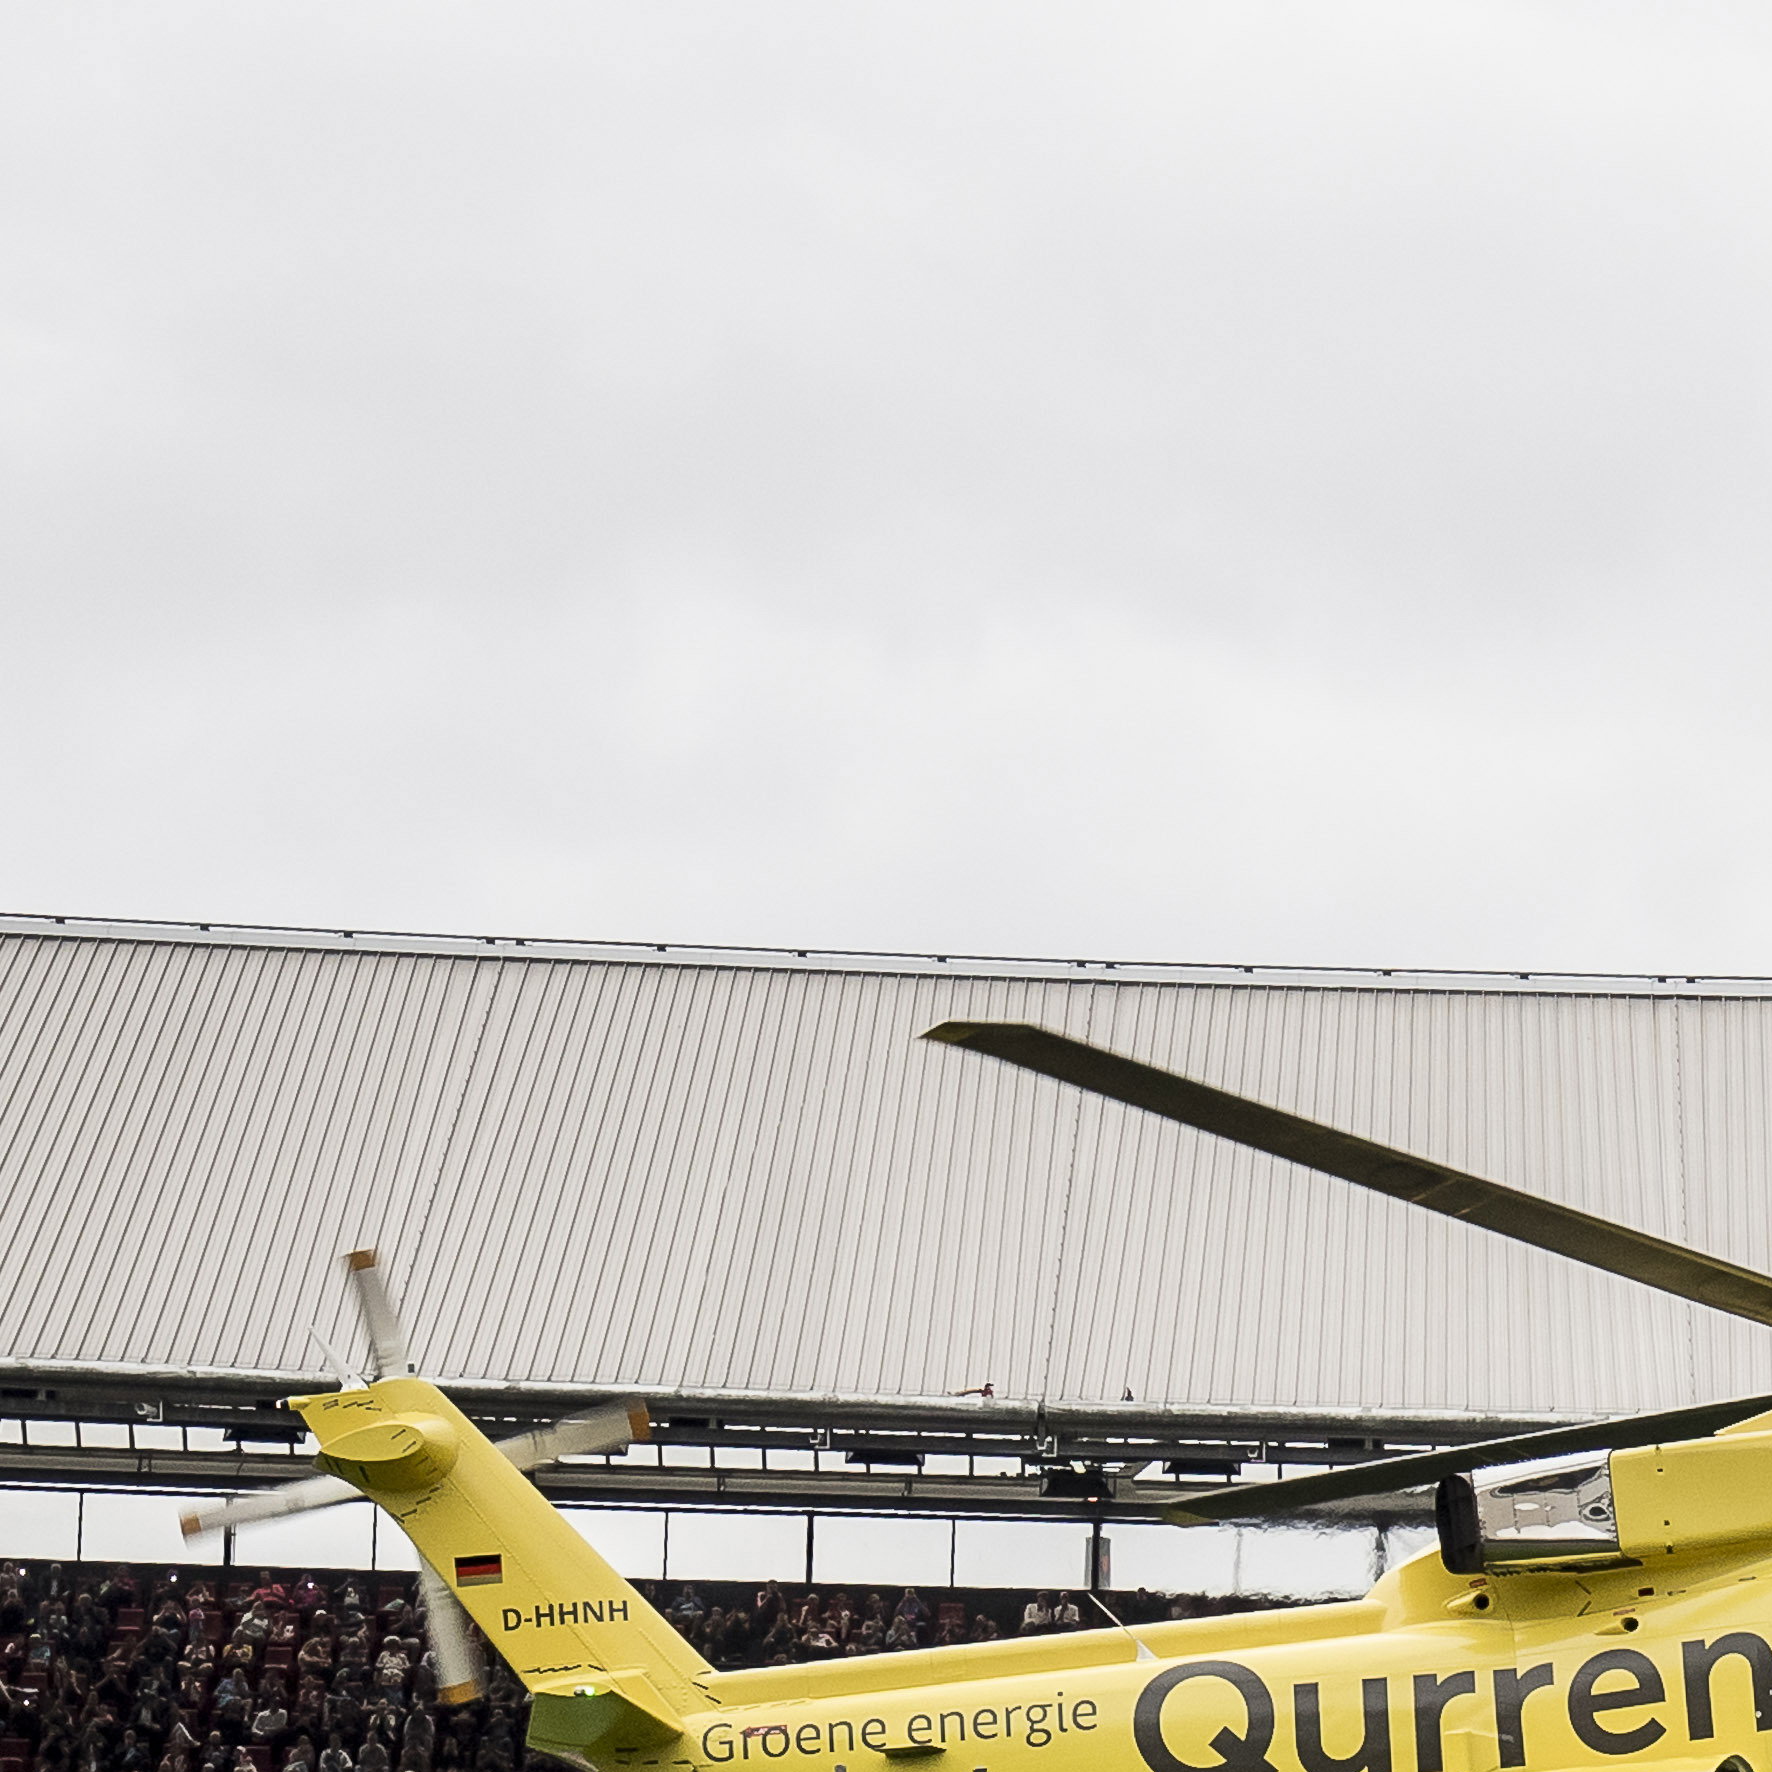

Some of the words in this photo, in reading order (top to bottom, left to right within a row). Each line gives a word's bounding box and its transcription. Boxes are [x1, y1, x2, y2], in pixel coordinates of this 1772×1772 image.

[502, 1600, 630, 1631] D-HHNH
[702, 1717, 887, 1763] Groene
[907, 1691, 1098, 1747] energie
